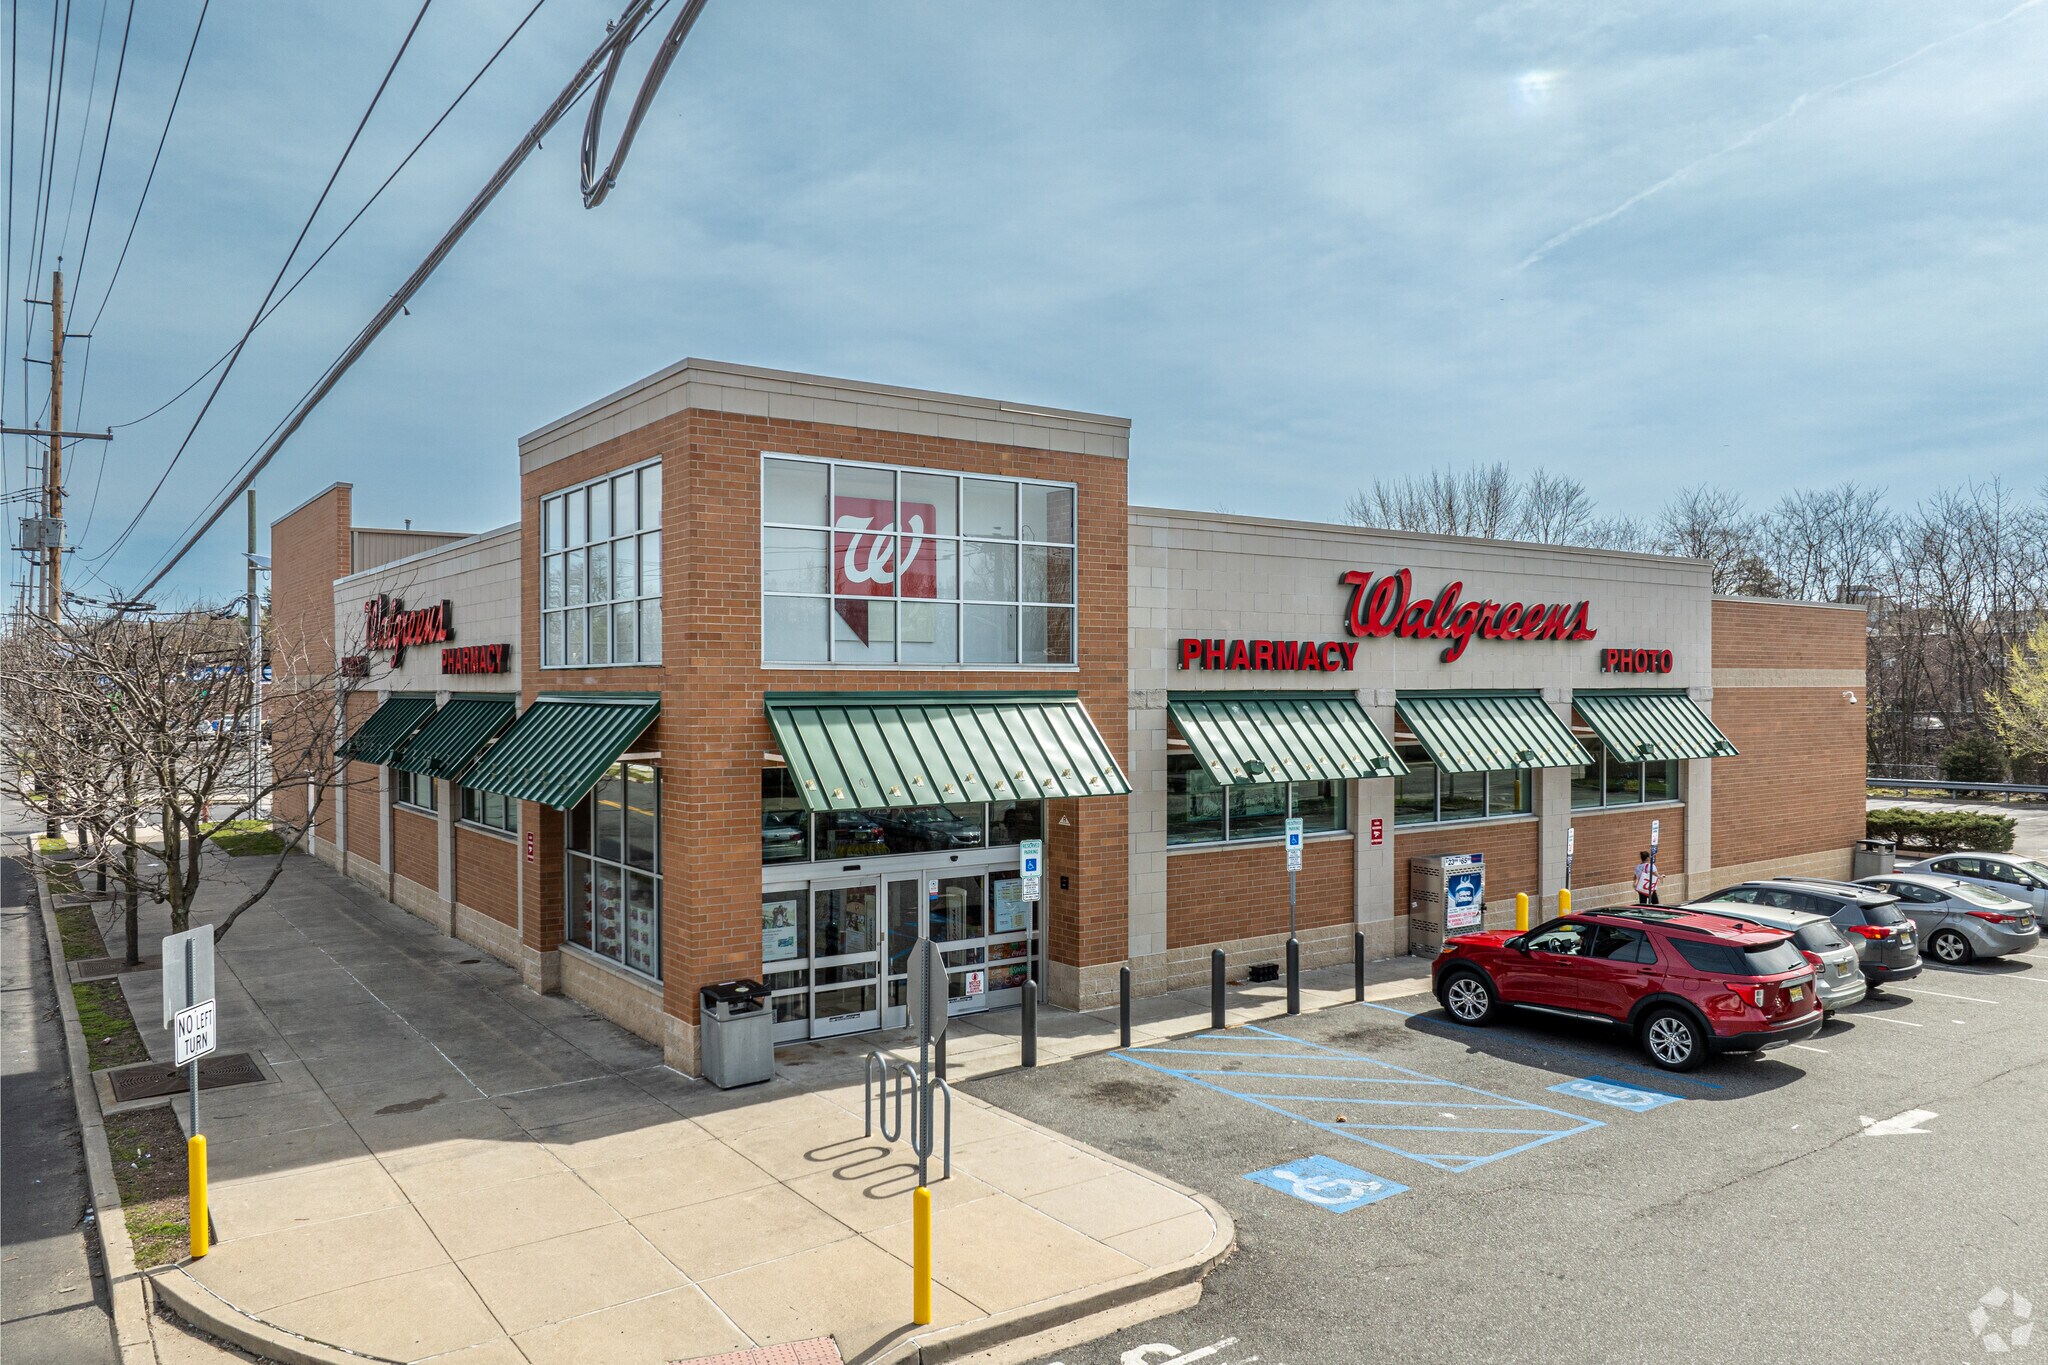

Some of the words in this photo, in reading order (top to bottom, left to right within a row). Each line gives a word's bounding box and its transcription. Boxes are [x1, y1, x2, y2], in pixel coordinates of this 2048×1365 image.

[835, 514, 924, 584] W
[364, 593, 452, 669] Walgreens
[1339, 567, 1598, 663] Walgreens
[441, 643, 507, 674] PHARMACY
[1180, 638, 1360, 672] PHARMACY
[1603, 648, 1674, 674] PHOTO
[178, 1014, 193, 1038] NO
[196, 1009, 212, 1031] LEFT
[184, 1031, 208, 1056] TURN
